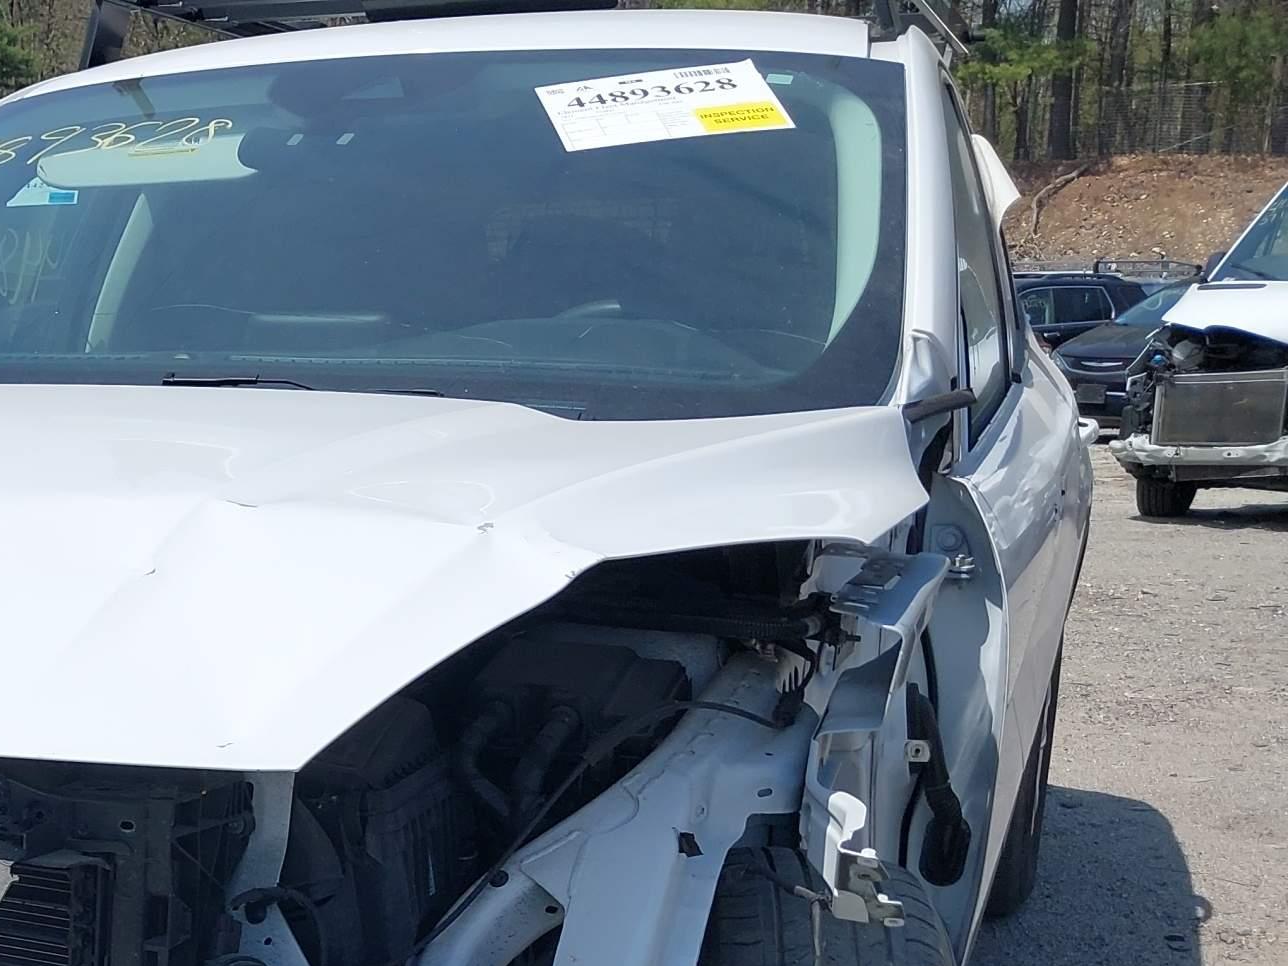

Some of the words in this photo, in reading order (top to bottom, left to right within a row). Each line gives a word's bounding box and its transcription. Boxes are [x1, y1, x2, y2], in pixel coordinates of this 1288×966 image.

[567, 76, 737, 108] 44893628
[700, 107, 774, 119] INSPECTION
[714, 114, 768, 124] SERVICE
